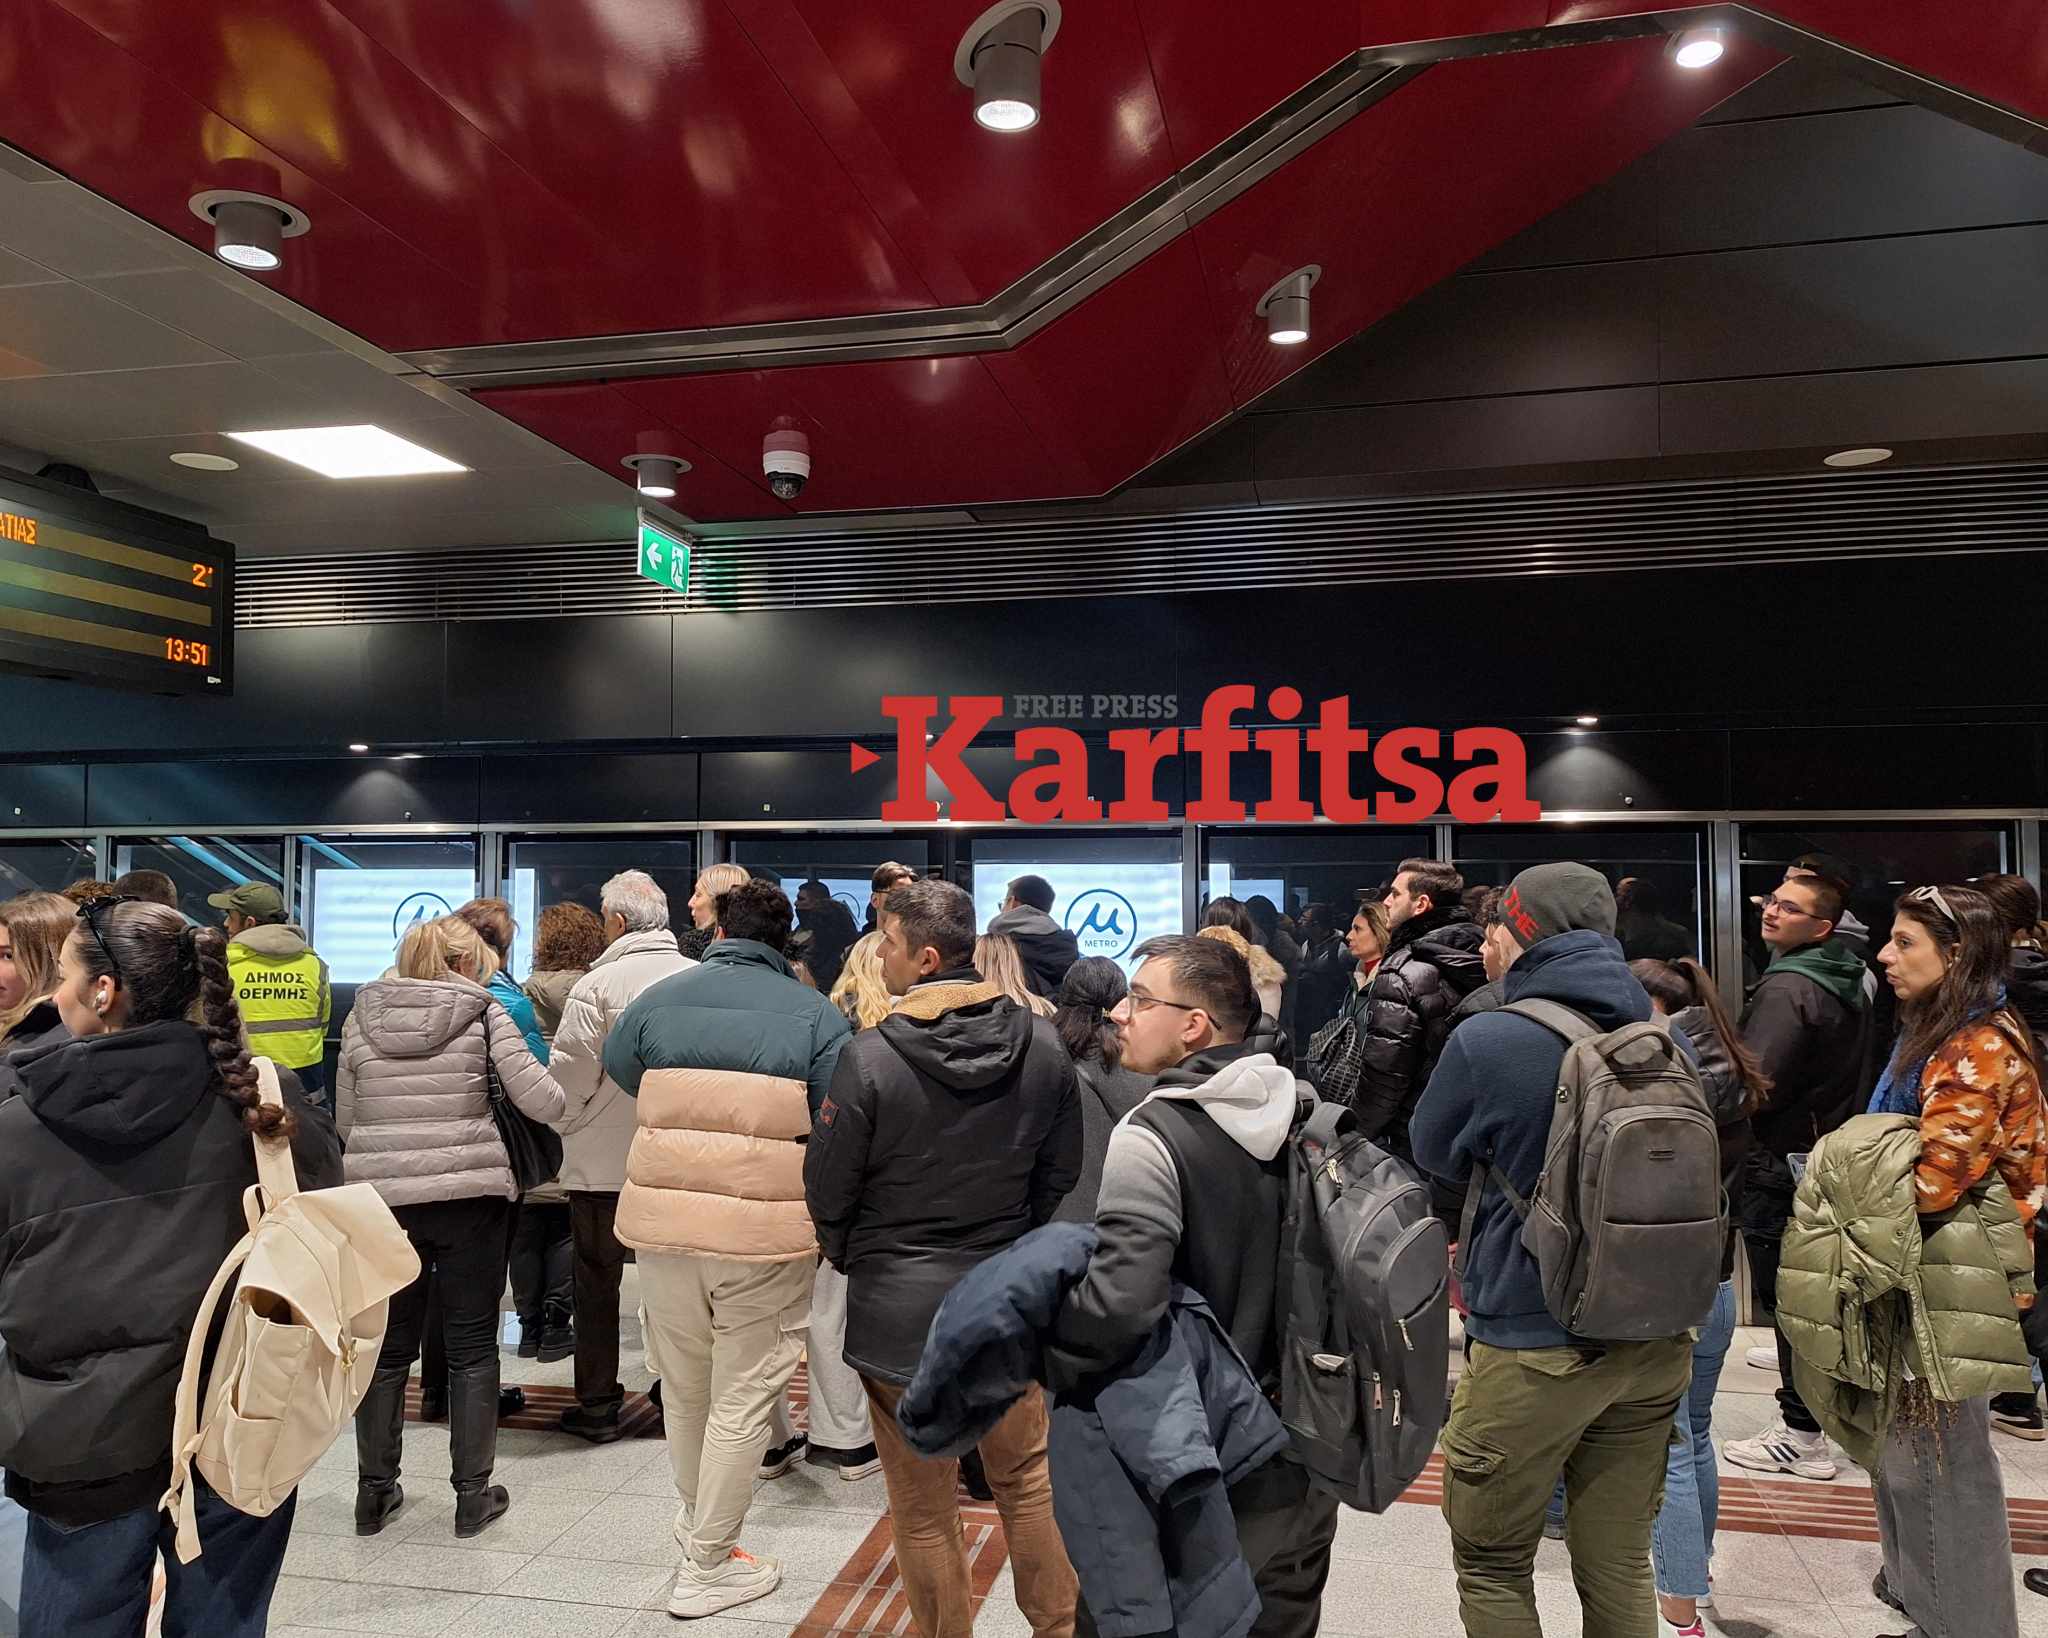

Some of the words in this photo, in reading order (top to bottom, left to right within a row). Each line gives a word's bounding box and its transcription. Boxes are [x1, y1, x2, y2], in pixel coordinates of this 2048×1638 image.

[165, 637, 207, 667] 13:51
[1084, 939, 1119, 949] METRO
[244, 971, 305, 984] ΔΗΜΟΣ
[239, 987, 309, 1000] ΘΕΡΜΗΣ
